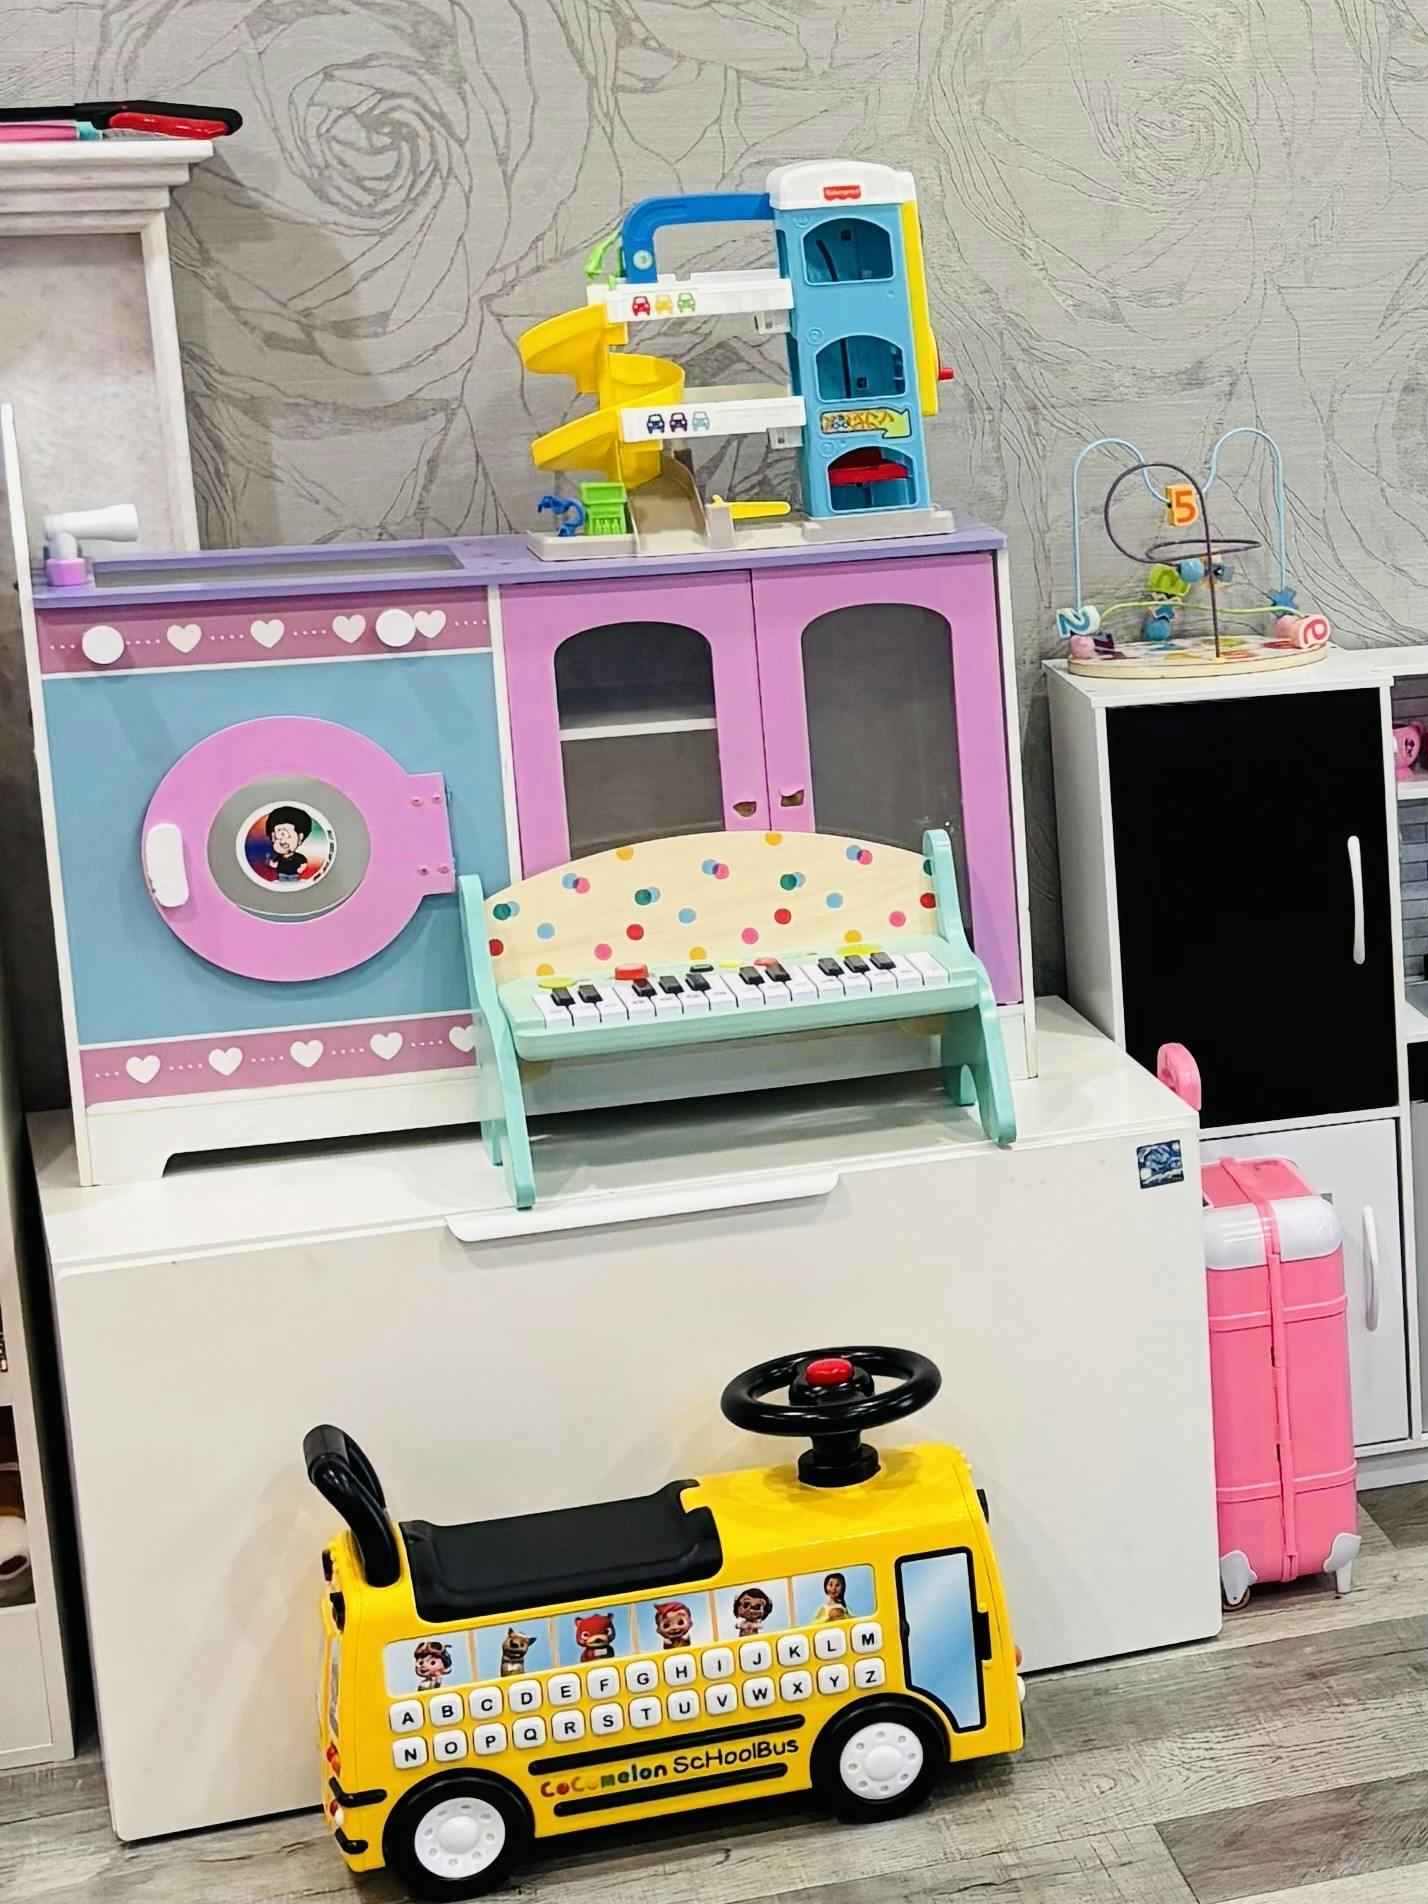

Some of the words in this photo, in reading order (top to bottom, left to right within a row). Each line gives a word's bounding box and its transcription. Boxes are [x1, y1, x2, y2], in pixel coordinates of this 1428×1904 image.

[1174, 489, 1197, 524] 5
[401, 1711, 415, 1725] A
[441, 1704, 454, 1719] B
[480, 1698, 493, 1712] C
[520, 1692, 533, 1706] D
[560, 1685, 572, 1699] E
[599, 1678, 609, 1692] F
[636, 1672, 650, 1686] G
[675, 1665, 688, 1679] H
[752, 1652, 762, 1666] J
[788, 1645, 801, 1659] K
[827, 1639, 837, 1652] L
[861, 1632, 875, 1646] M
[404, 1748, 418, 1762] N
[444, 1741, 458, 1755] O
[485, 1735, 496, 1749] P
[523, 1728, 538, 1741] Q
[564, 1721, 577, 1735] R
[602, 1714, 614, 1728] S
[640, 1707, 651, 1721] T
[678, 1701, 691, 1715] U
[716, 1694, 728, 1708] V
[752, 1687, 768, 1701] W
[792, 1681, 803, 1695] X
[829, 1675, 839, 1688] Y
[865, 1670, 877, 1684] Z
